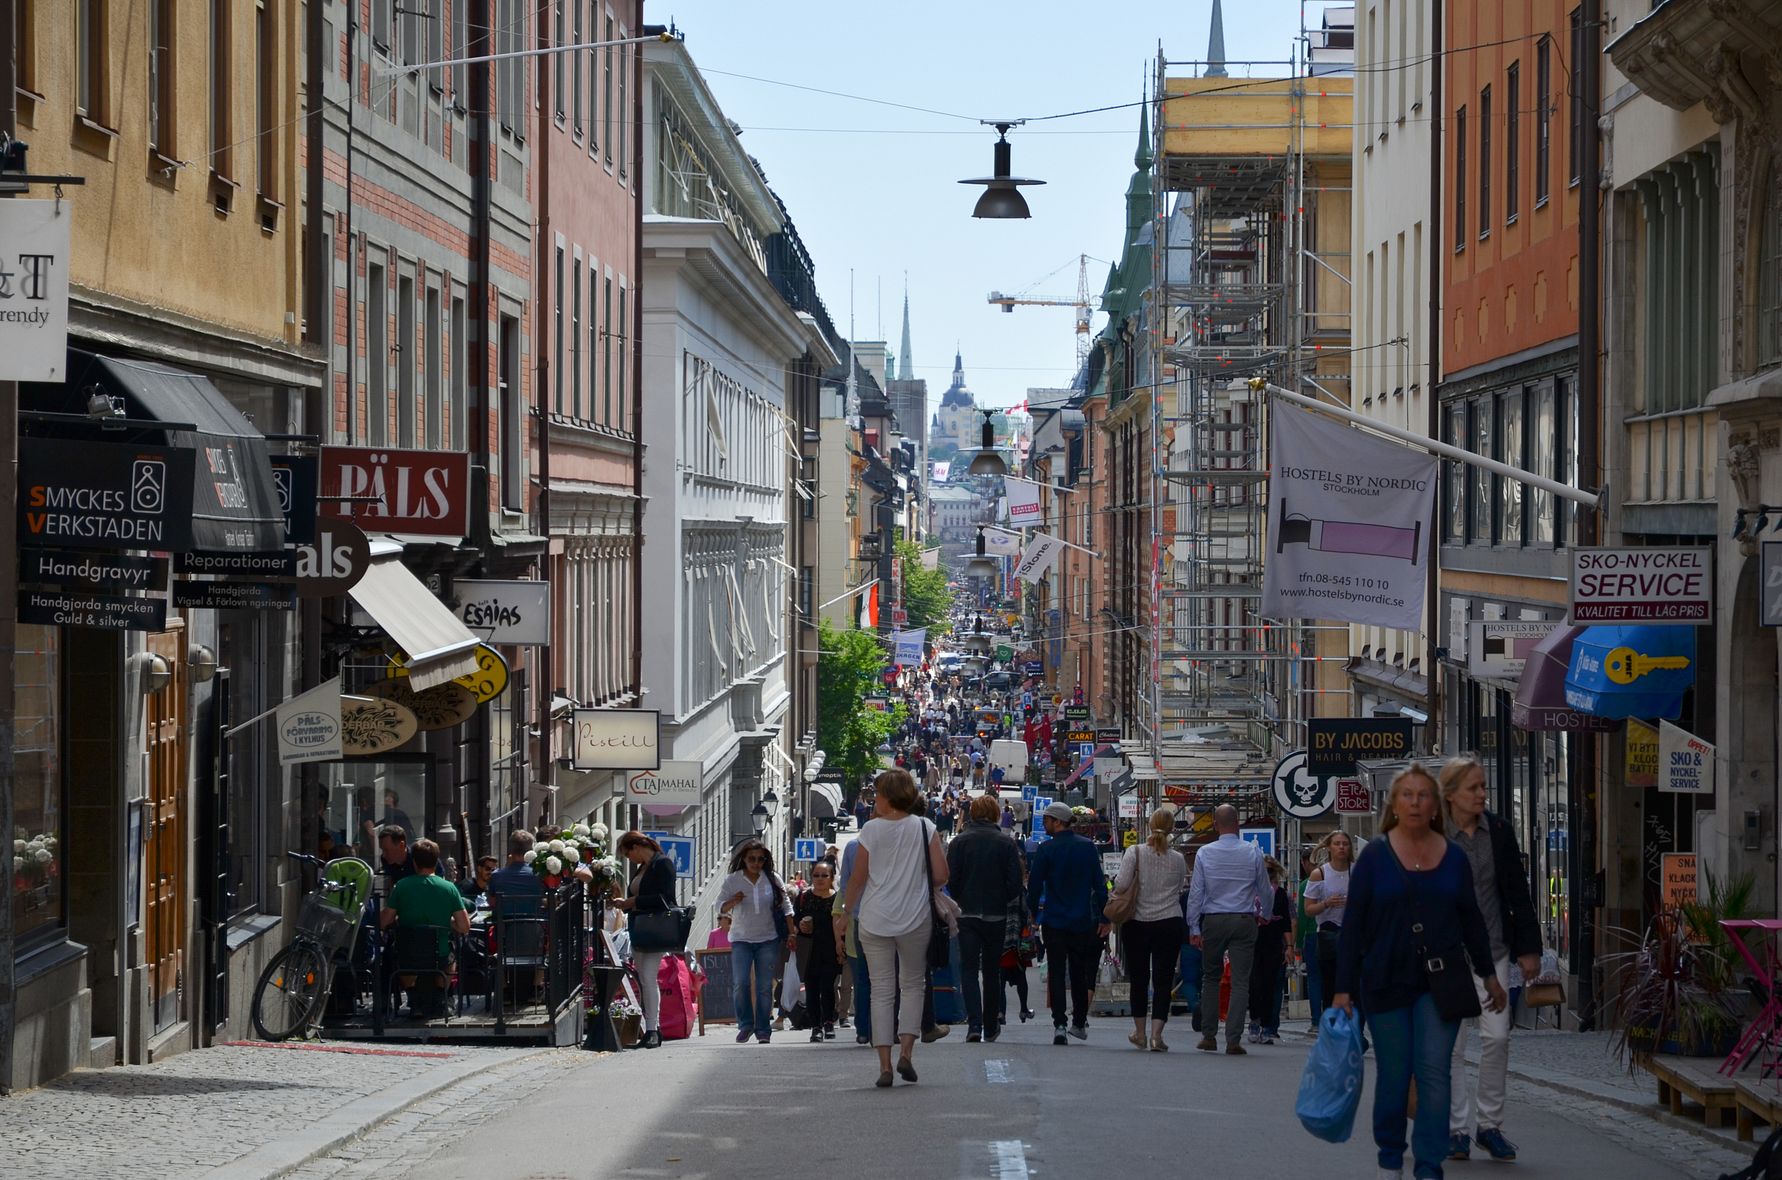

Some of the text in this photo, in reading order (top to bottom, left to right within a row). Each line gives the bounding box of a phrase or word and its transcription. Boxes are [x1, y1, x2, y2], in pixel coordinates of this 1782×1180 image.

[336, 453, 450, 520] PÄLS
[1280, 466, 1426, 492] HOSTELS BY NORDIC
[1323, 483, 1380, 497] STOCKHOLM
[30, 485, 125, 512] SMYCKES
[27, 512, 163, 541] VERKSTADEN
[184, 552, 288, 571] Reparationer
[1578, 553, 1702, 569] SKO-NYCKEL
[39, 557, 151, 584] Handgravyr
[1299, 571, 1389, 590] tfn.08-545 110 10
[1578, 573, 1703, 597] SERVICE
[208, 585, 261, 597] Handgjorda
[1280, 587, 1405, 608] www.hostelsbynordic.se
[31, 595, 154, 615] Handgjorda smycken
[177, 596, 204, 607] Vigsel
[206, 597, 214, 606] &
[1577, 604, 1704, 617] KVALITET TILL LÅG PRIS
[54, 612, 130, 627] Guld & silver
[1487, 624, 1526, 632] HOSTELS
[1529, 624, 1541, 632] BY
[578, 720, 655, 760] Pistill
[1068, 732, 1094, 740] CARAT
[1315, 732, 1404, 749] BY JACOBS
[1629, 743, 1637, 752] VI
[1687, 738, 1711, 756] ÖPPET!
[1316, 753, 1341, 761] HAIR
[1348, 753, 1354, 761] &
[1670, 752, 1702, 766] SKO &
[1670, 767, 1702, 778] NYCKEL-
[1670, 779, 1700, 789] SERVICE
[1339, 797, 1368, 809] STORE
